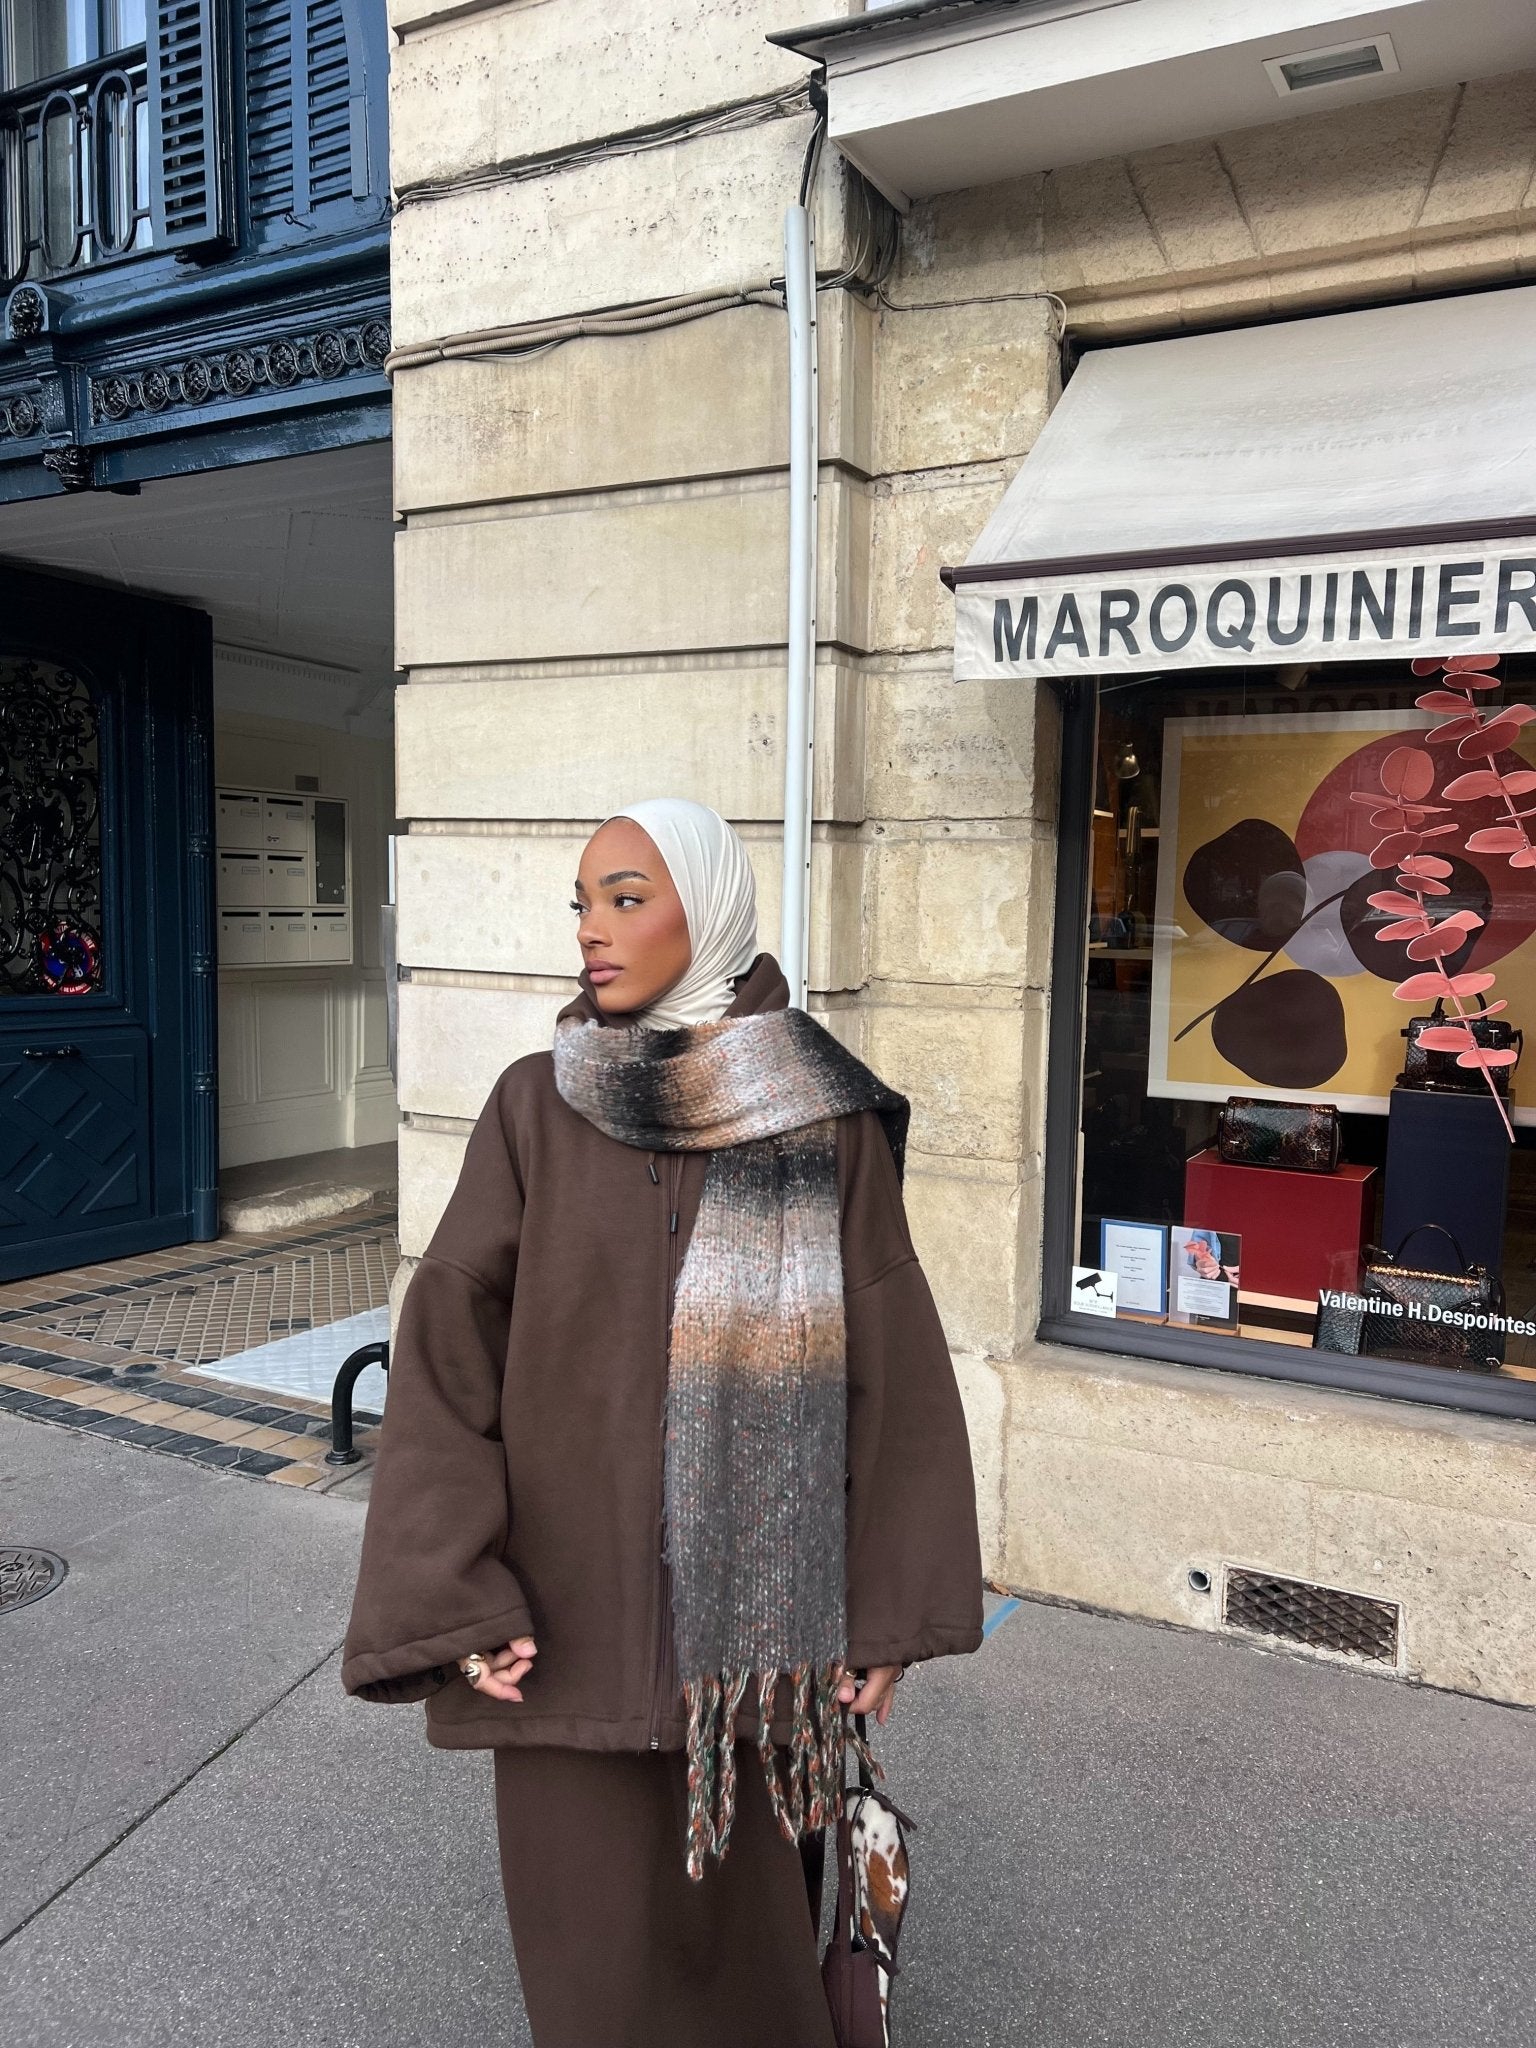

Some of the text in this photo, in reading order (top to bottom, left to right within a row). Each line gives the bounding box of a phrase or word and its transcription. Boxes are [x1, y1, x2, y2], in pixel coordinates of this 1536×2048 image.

[993, 558, 1536, 663] MAROQUINIER
[1319, 1289, 1536, 1336] Valentine H.Despointes
